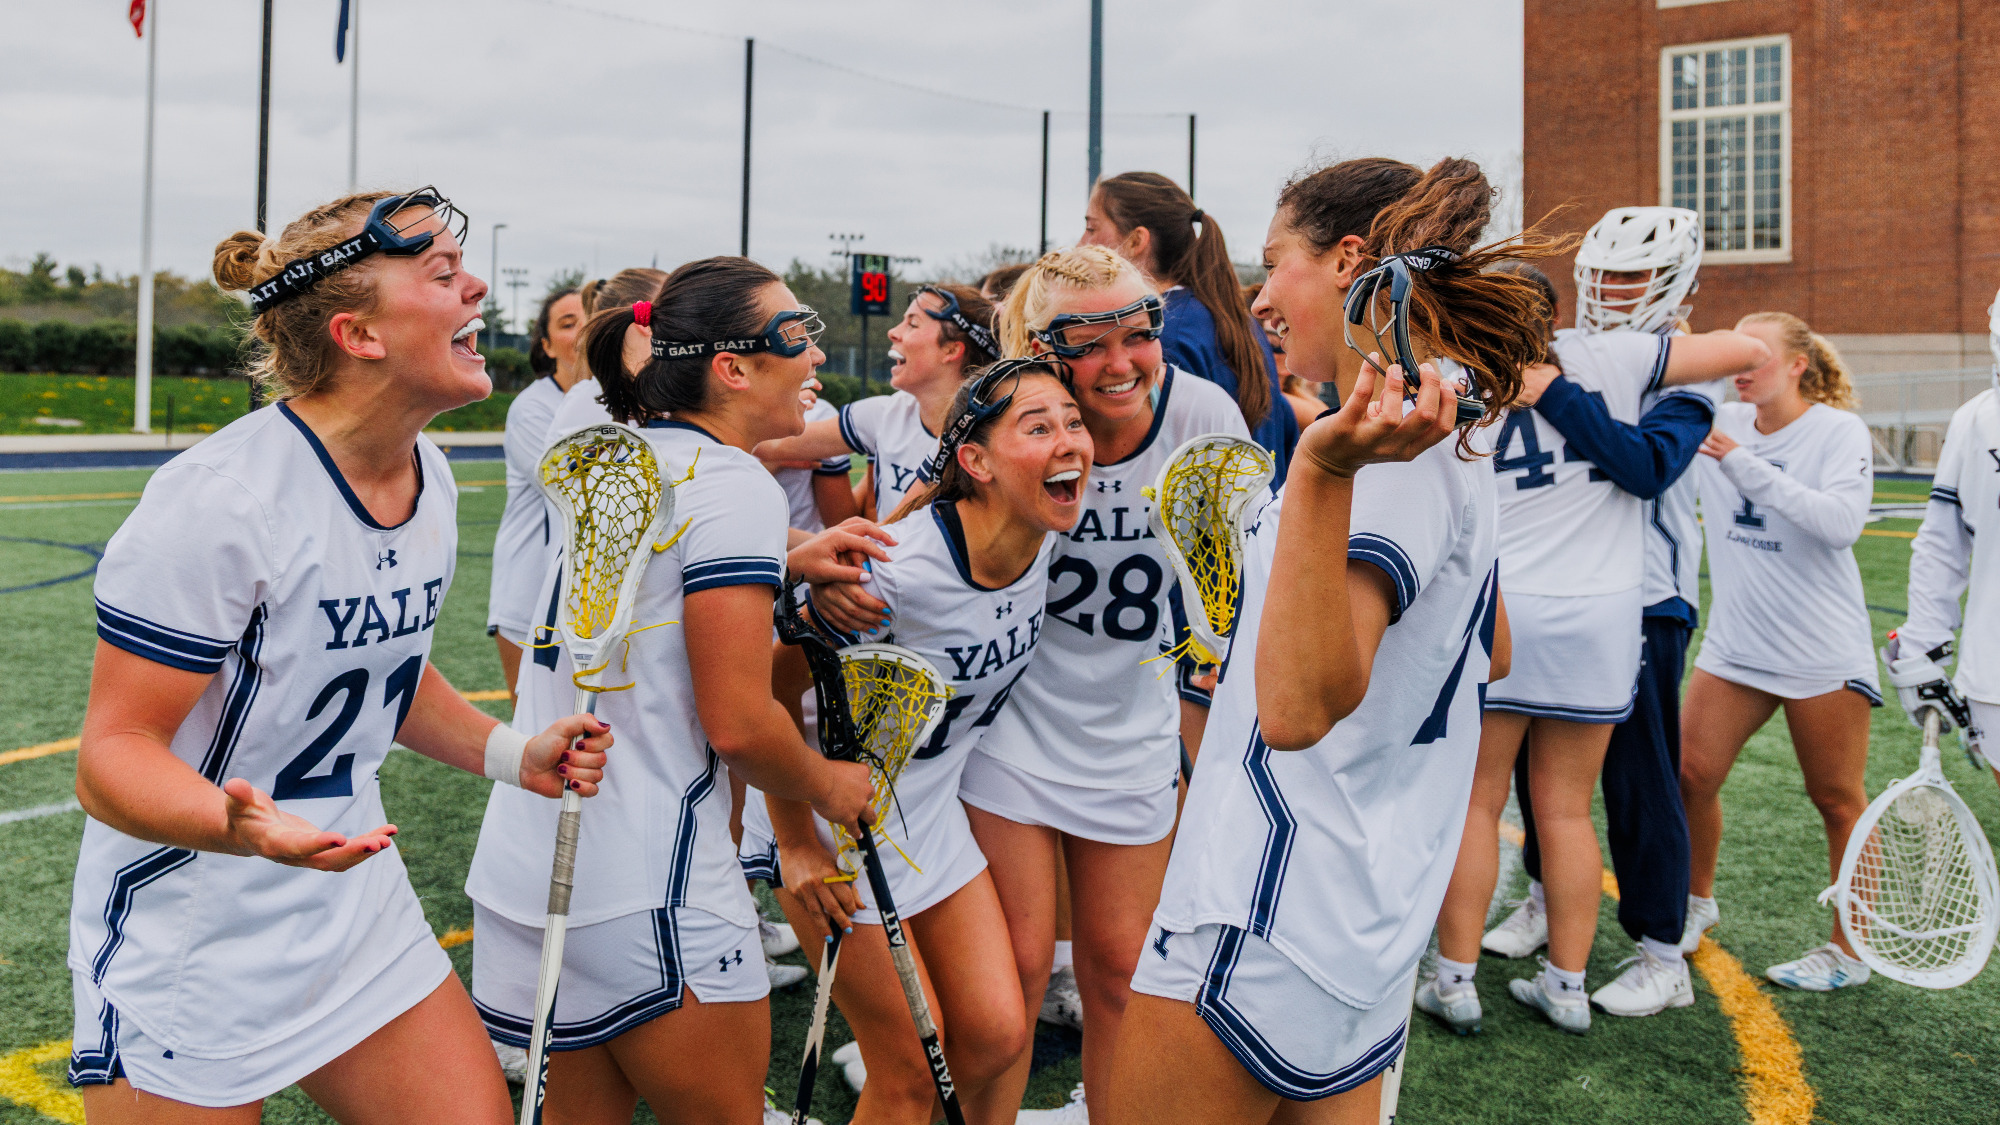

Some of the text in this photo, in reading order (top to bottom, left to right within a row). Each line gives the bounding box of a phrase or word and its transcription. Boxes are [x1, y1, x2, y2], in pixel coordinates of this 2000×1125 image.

[320, 239, 362, 267] GAIT
[861, 271, 887, 303] 90
[668, 343, 705, 357] GAIT
[713, 339, 756, 351] GAIT
[1060, 506, 1157, 543] AL
[318, 577, 443, 650] YALE
[1046, 553, 1163, 642] 28
[945, 605, 1043, 681] YALE
[271, 653, 423, 801] 21
[881, 910, 906, 945] AIT
[928, 1040, 955, 1101] YALE
